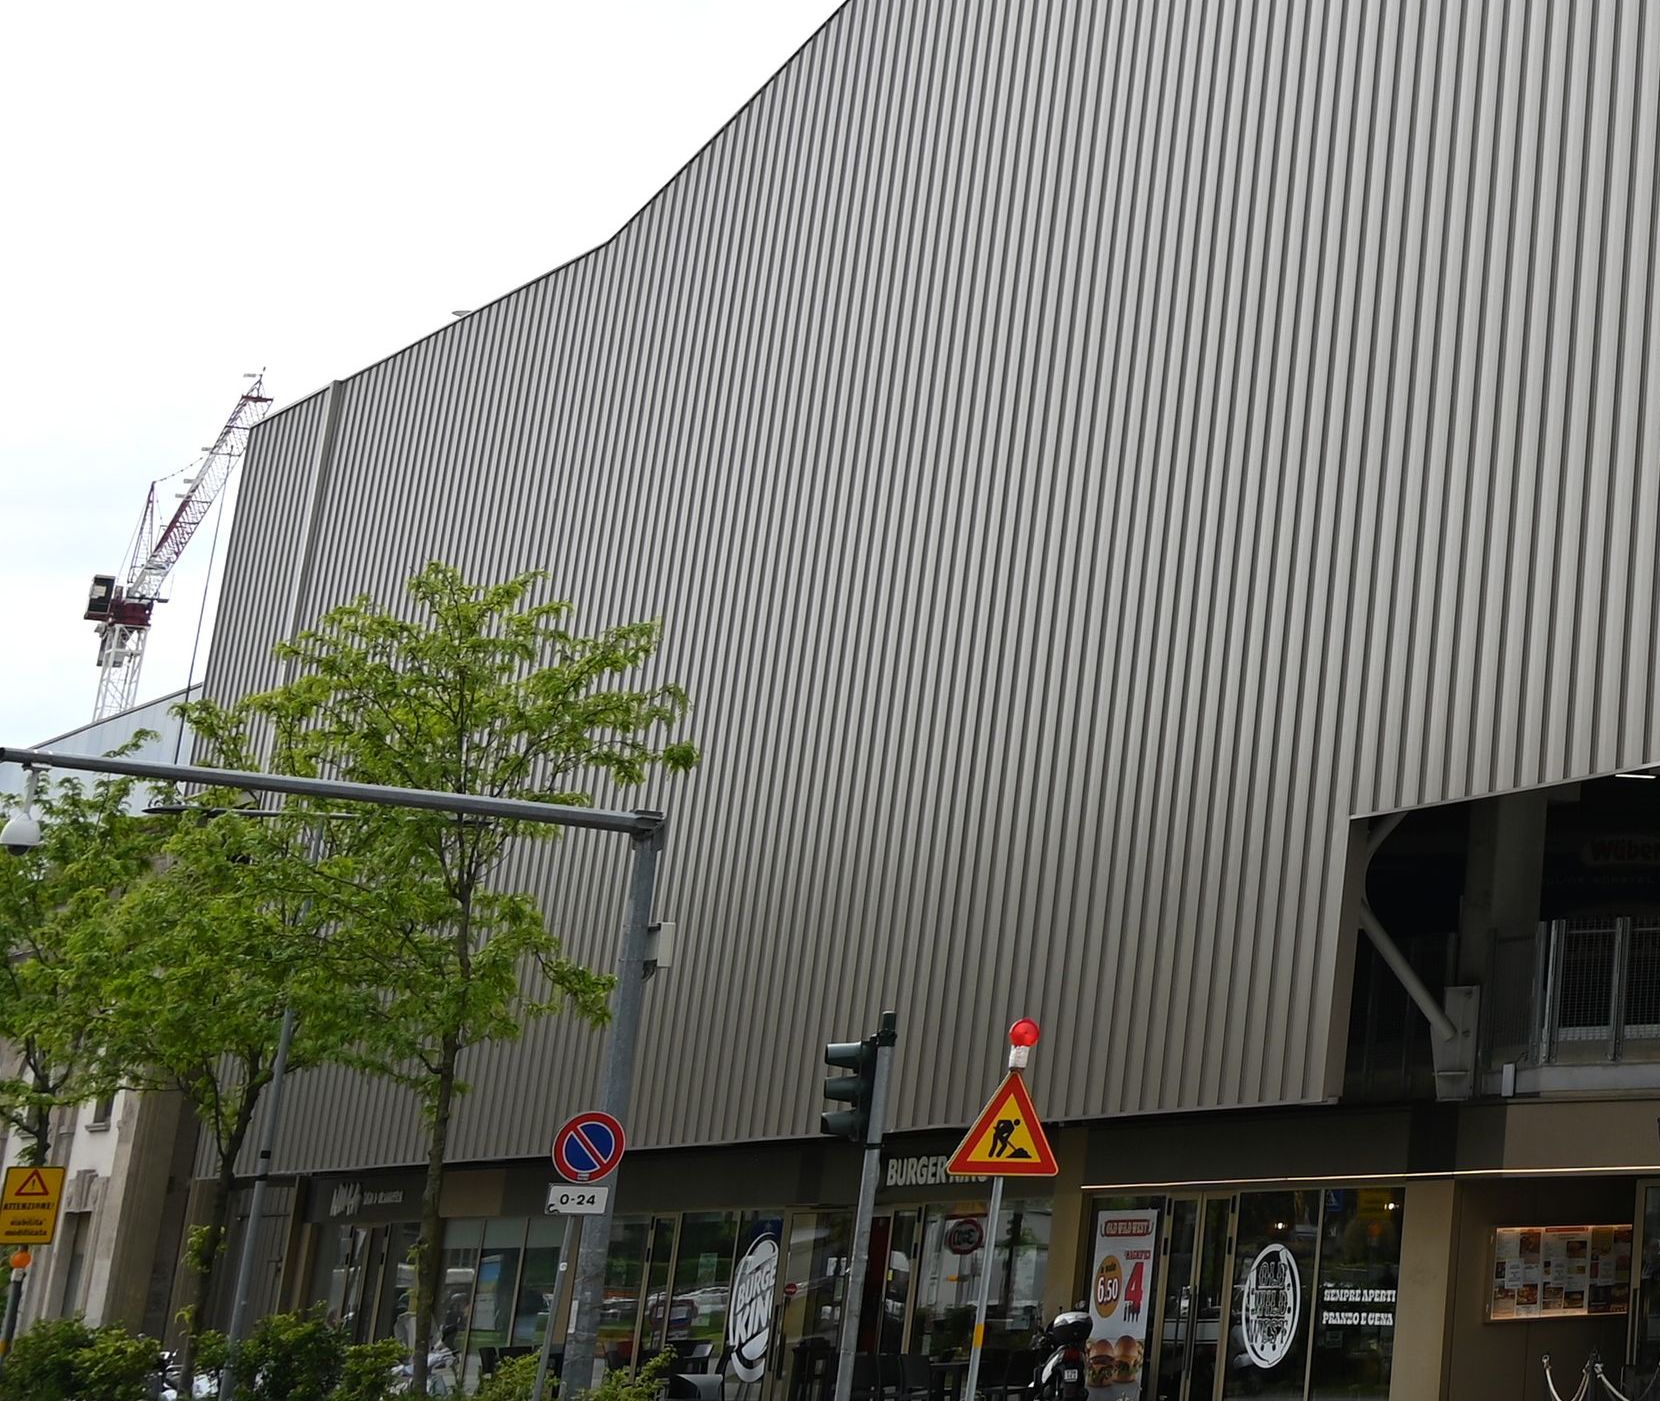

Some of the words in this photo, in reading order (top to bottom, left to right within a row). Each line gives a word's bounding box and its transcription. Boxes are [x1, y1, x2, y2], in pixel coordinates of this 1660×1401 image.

[886, 1155, 948, 1186] BURGER
[559, 1193, 596, 1205] 0-24
[1323, 1289, 1361, 1302] SEMPRE
[1361, 1289, 1396, 1303] APERTI
[1322, 1311, 1360, 1325] PRANZO
[1360, 1312, 1367, 1325] E
[1367, 1312, 1393, 1326] CENA
